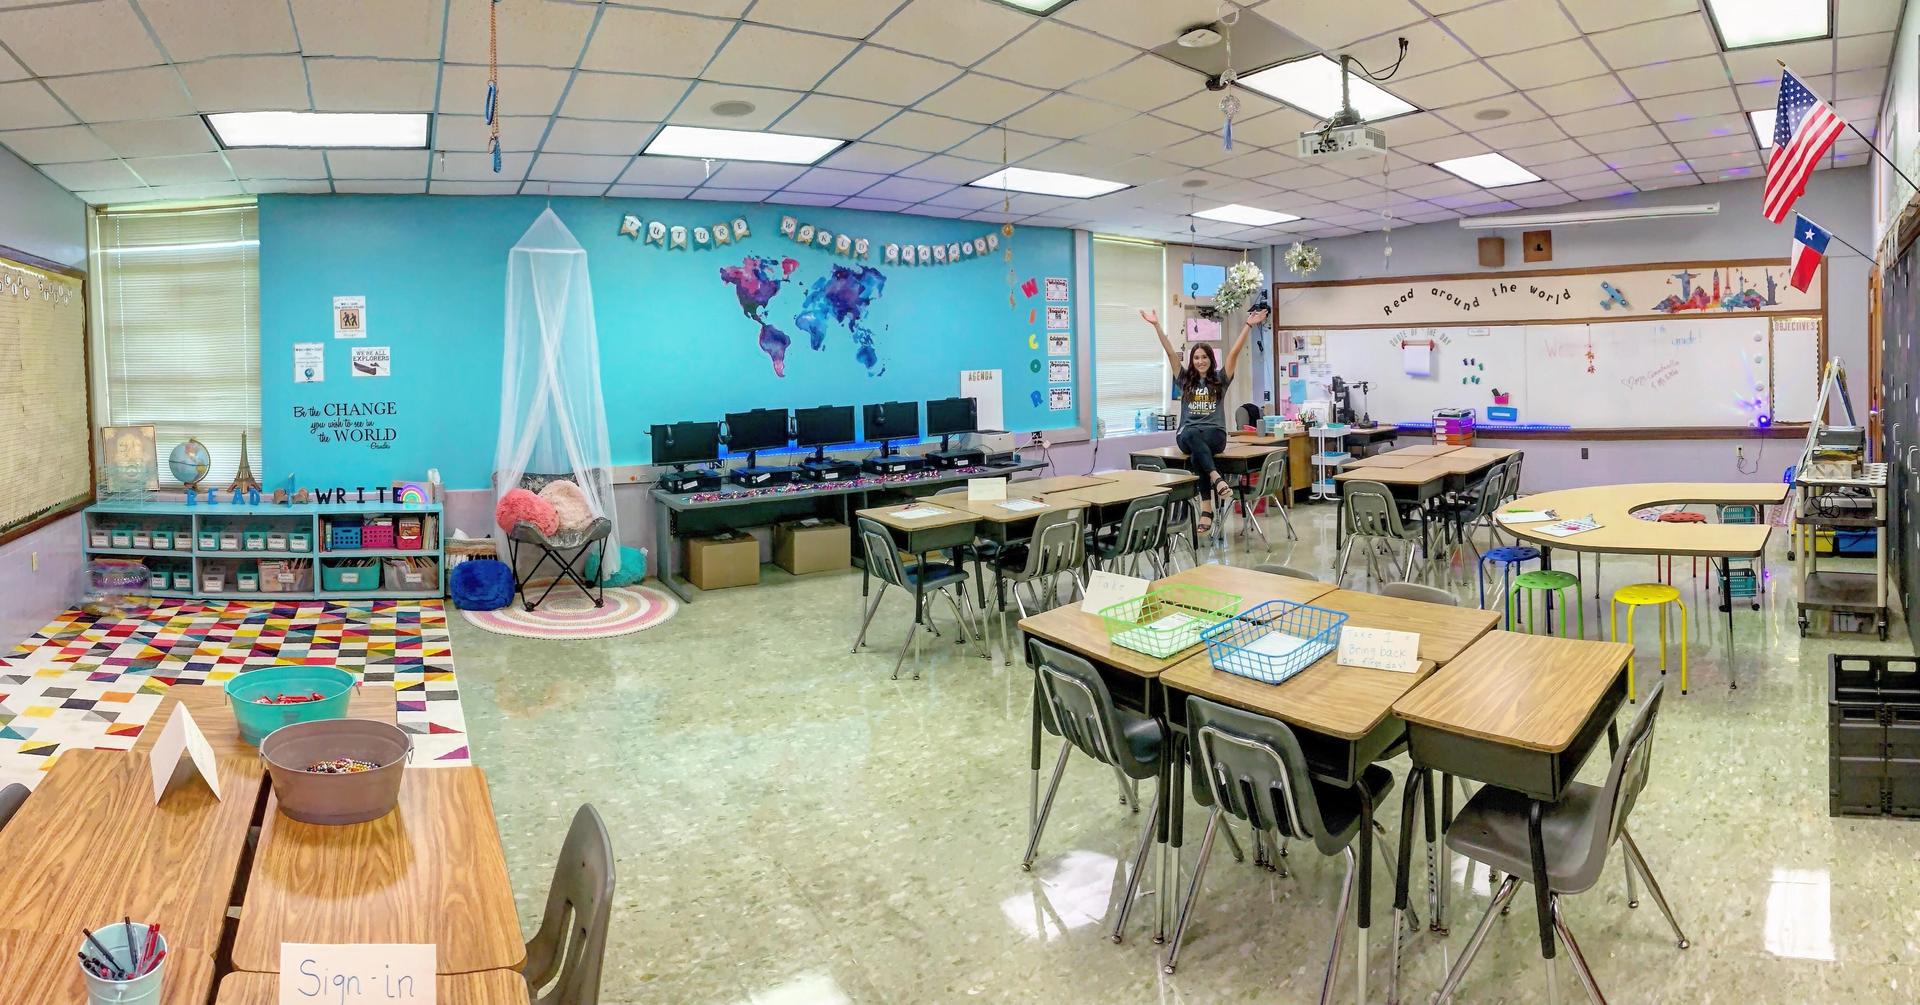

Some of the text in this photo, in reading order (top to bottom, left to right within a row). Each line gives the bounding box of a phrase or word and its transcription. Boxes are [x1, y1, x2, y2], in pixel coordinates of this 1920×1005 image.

[1383, 283, 1571, 316] Read around the world
[1775, 321, 1816, 331] OBJECTIVES
[968, 371, 993, 381] AGENDA
[293, 402, 397, 418] Be the CHANGE
[1188, 400, 1217, 410] ACHIEVE
[310, 421, 326, 434] you
[328, 417, 343, 429] wish
[344, 418, 353, 428] to
[366, 418, 375, 427] in
[318, 428, 397, 443] the WORLD
[184, 486, 404, 506] READ WRITE
[1380, 645, 1408, 658] back
[297, 958, 414, 1005] Sign-in
